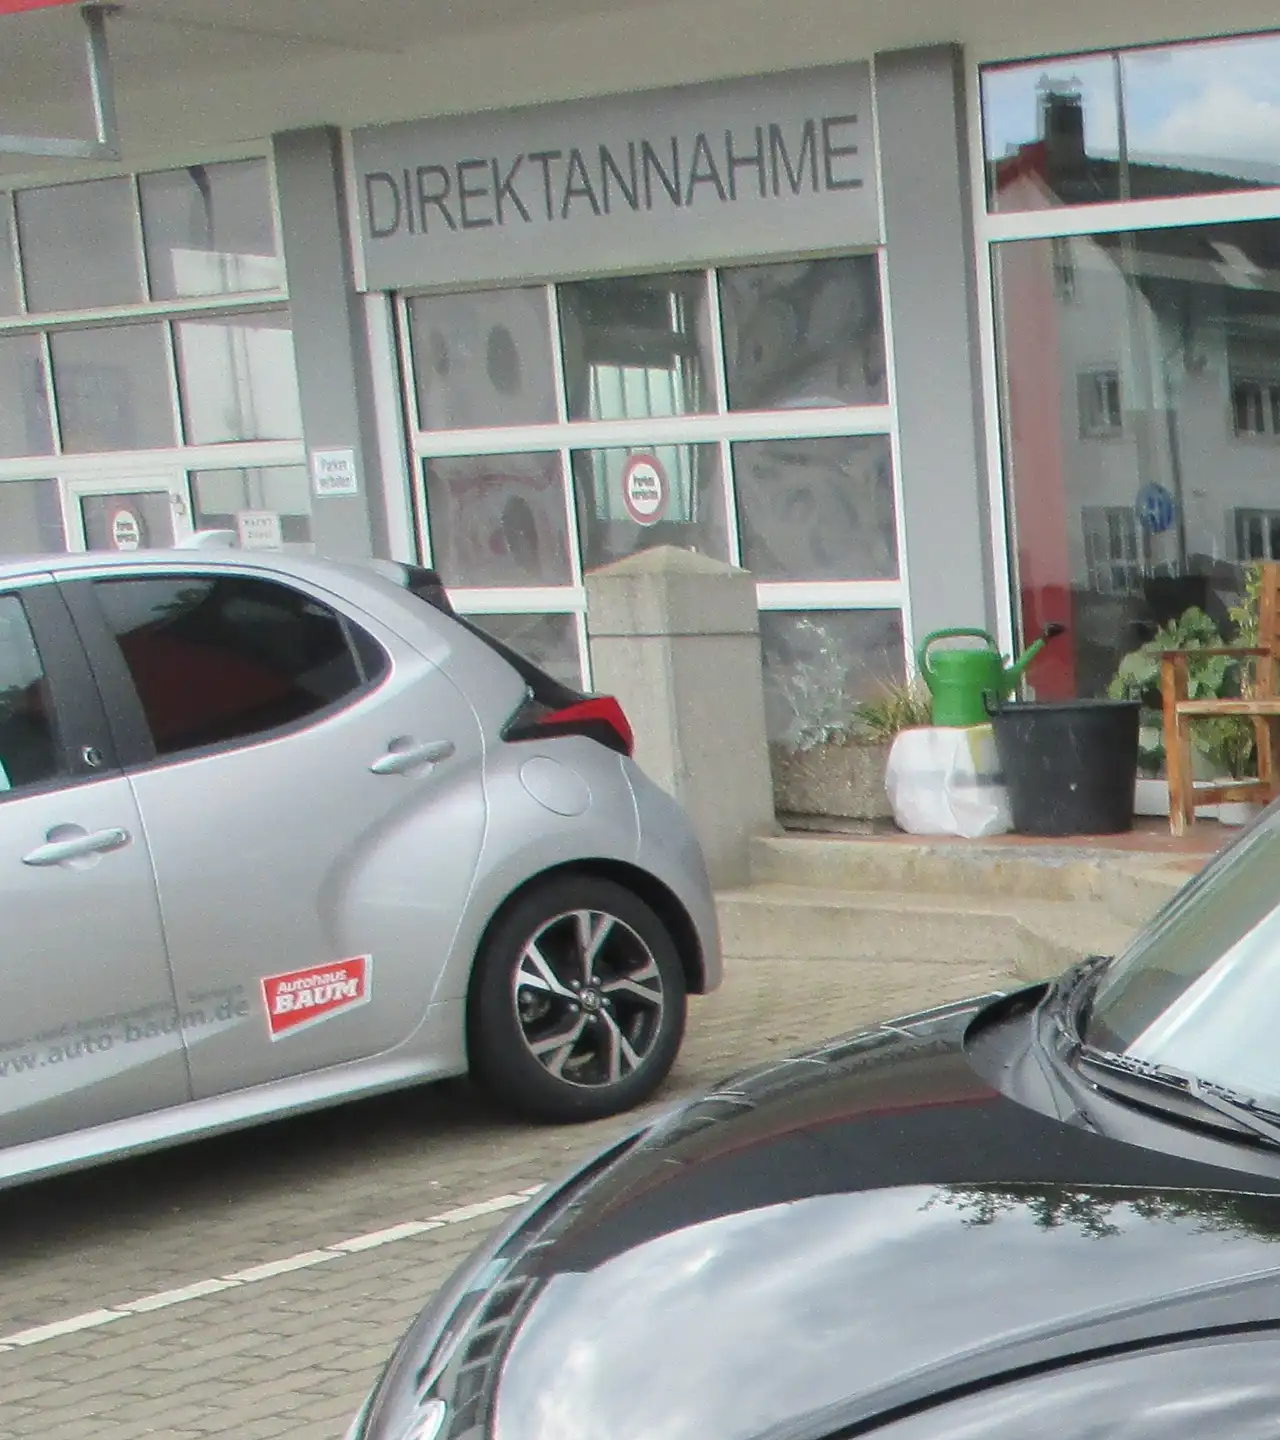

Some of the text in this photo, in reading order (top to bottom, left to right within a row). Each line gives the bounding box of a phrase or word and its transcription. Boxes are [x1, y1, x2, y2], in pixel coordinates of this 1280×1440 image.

[364, 115, 865, 239] DIREKTANNAHME
[273, 977, 358, 1015] BAUM
[277, 968, 348, 994] Autohaus
